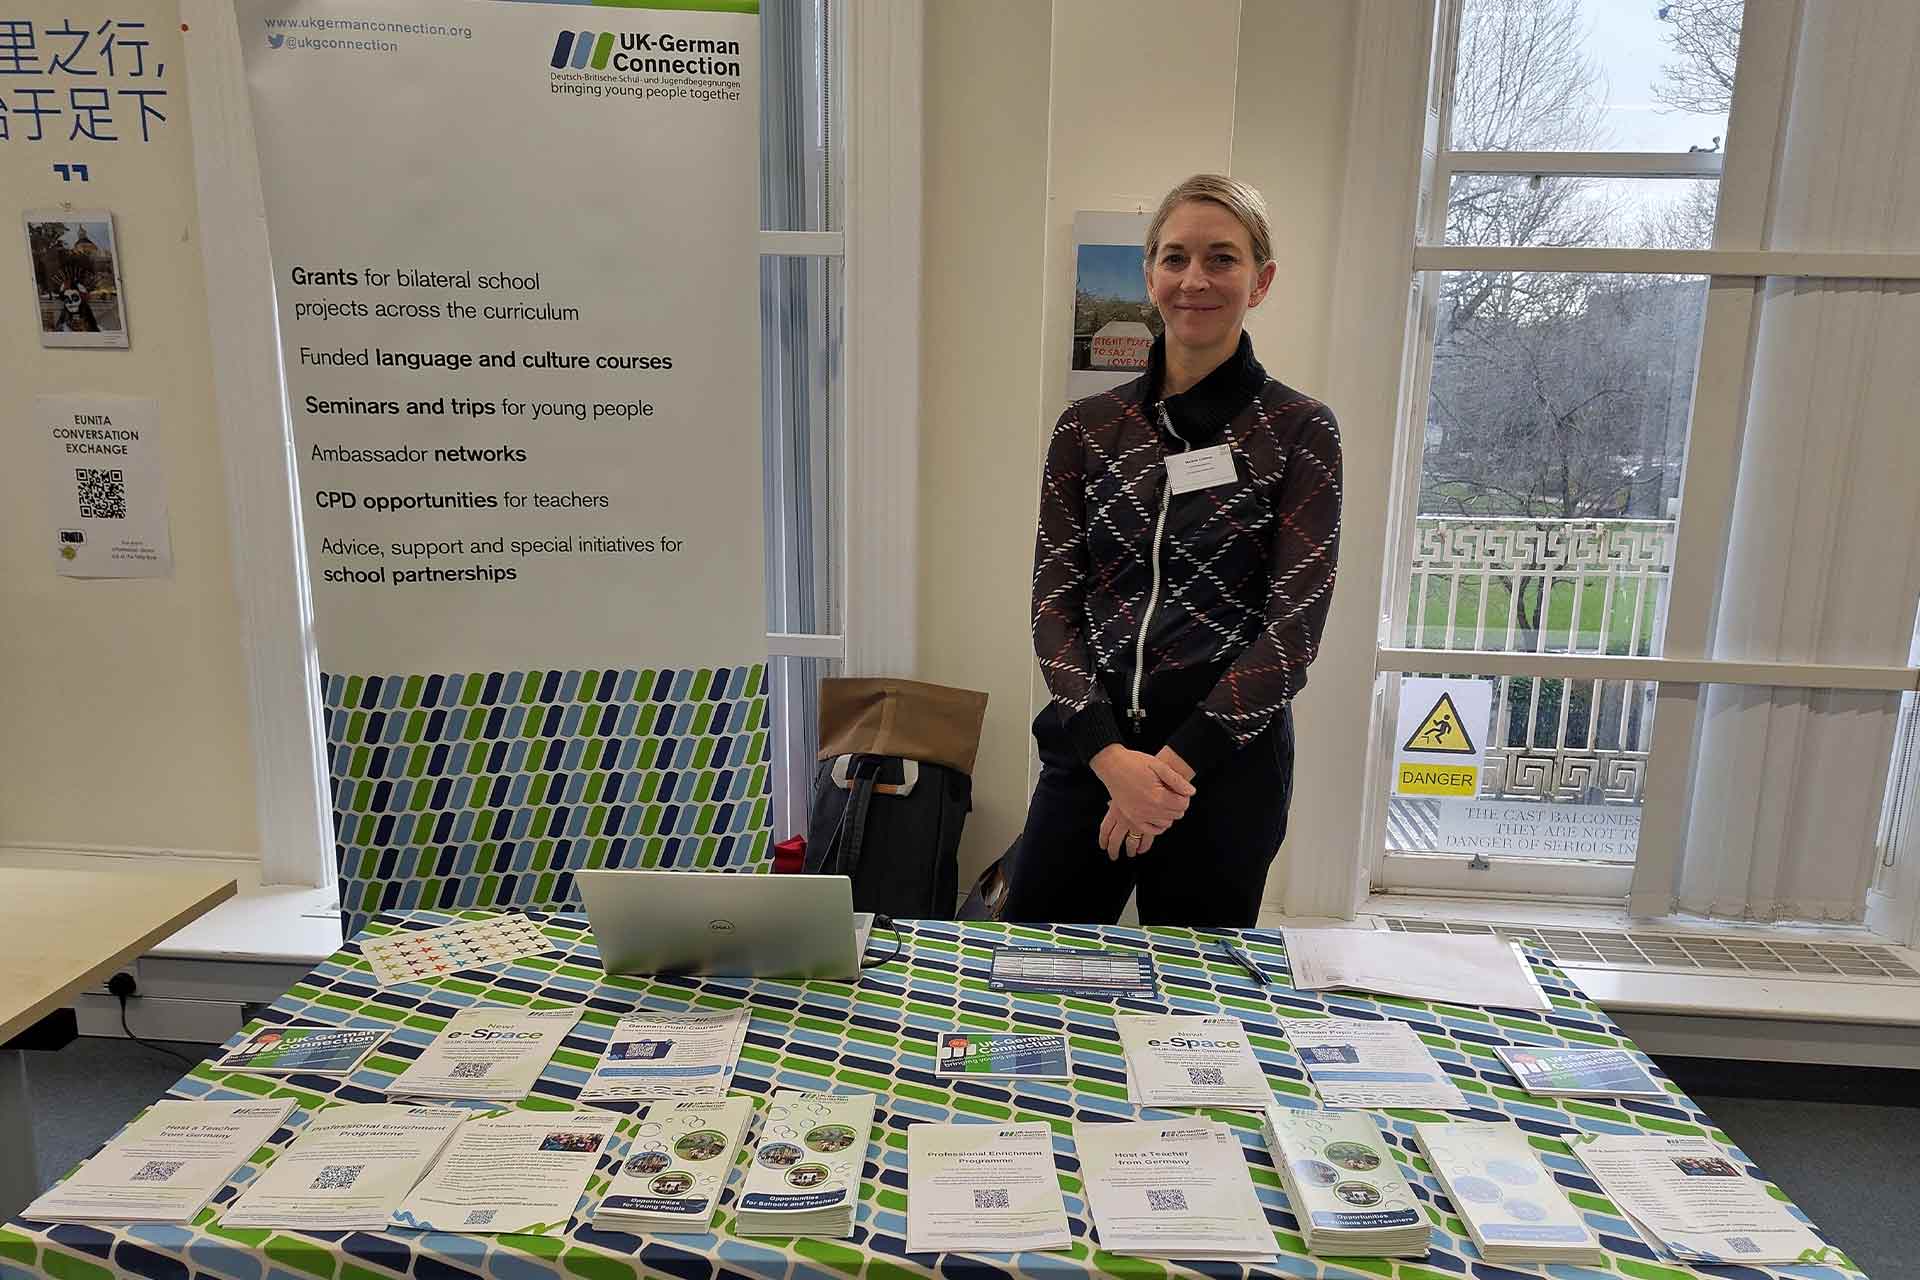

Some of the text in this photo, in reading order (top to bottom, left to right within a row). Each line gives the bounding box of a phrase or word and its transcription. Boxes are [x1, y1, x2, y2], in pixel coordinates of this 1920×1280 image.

[264, 17, 472, 39] www.ukgermanconnection.org
[287, 37, 398, 51] @ukgconnection
[620, 32, 740, 55] UK-German
[613, 52, 740, 77] Connection
[550, 72, 617, 82] Deutsch-Britische
[644, 75, 658, 84] und
[660, 76, 741, 89] Jugendbegegnungen
[551, 82, 740, 101] bringing young people together
[0, 87, 167, 142] 于足下
[291, 266, 540, 290] Grants for bilateral school
[295, 300, 579, 321] projects across the curriculum
[300, 347, 673, 371] Funded language and culture courses
[305, 396, 654, 420] Seminars and trips for young people
[74, 414, 112, 425] EUNITA
[52, 428, 139, 441] CONVERSATION
[66, 443, 128, 455] EXCHANGE
[311, 444, 527, 463] Ambassador networks
[315, 491, 609, 512] CPD opportunities for teachers
[321, 535, 683, 560] Advice, support and special initiatives for
[324, 564, 517, 586] school partnerships
[1402, 771, 1473, 787] DANGER
[1465, 807, 1499, 820] THE
[1503, 808, 1545, 822] CAST
[1496, 823, 1538, 837] THEY
[1544, 825, 1577, 837] ARE
[1583, 827, 1617, 840] NOT
[1446, 836, 1512, 849] DANGER
[1518, 838, 1540, 850] OF
[1544, 840, 1614, 855] SERIOUS
[286, 1031, 376, 1045] UK-German
[447, 1028, 543, 1041] e-Space
[979, 1035, 1056, 1048] UK-German
[277, 1036, 374, 1050] Connection
[978, 1040, 1061, 1054] Connection
[1148, 1037, 1240, 1049] e-Space
[1551, 1055, 1627, 1070] Connection
[312, 1123, 381, 1132] Professional
[630, 1197, 681, 1205] Opportunities
[769, 1194, 820, 1202] Opportunities
[806, 1197, 839, 1206] Teachers
[635, 1203, 659, 1211] Young
[659, 1204, 685, 1212] People
